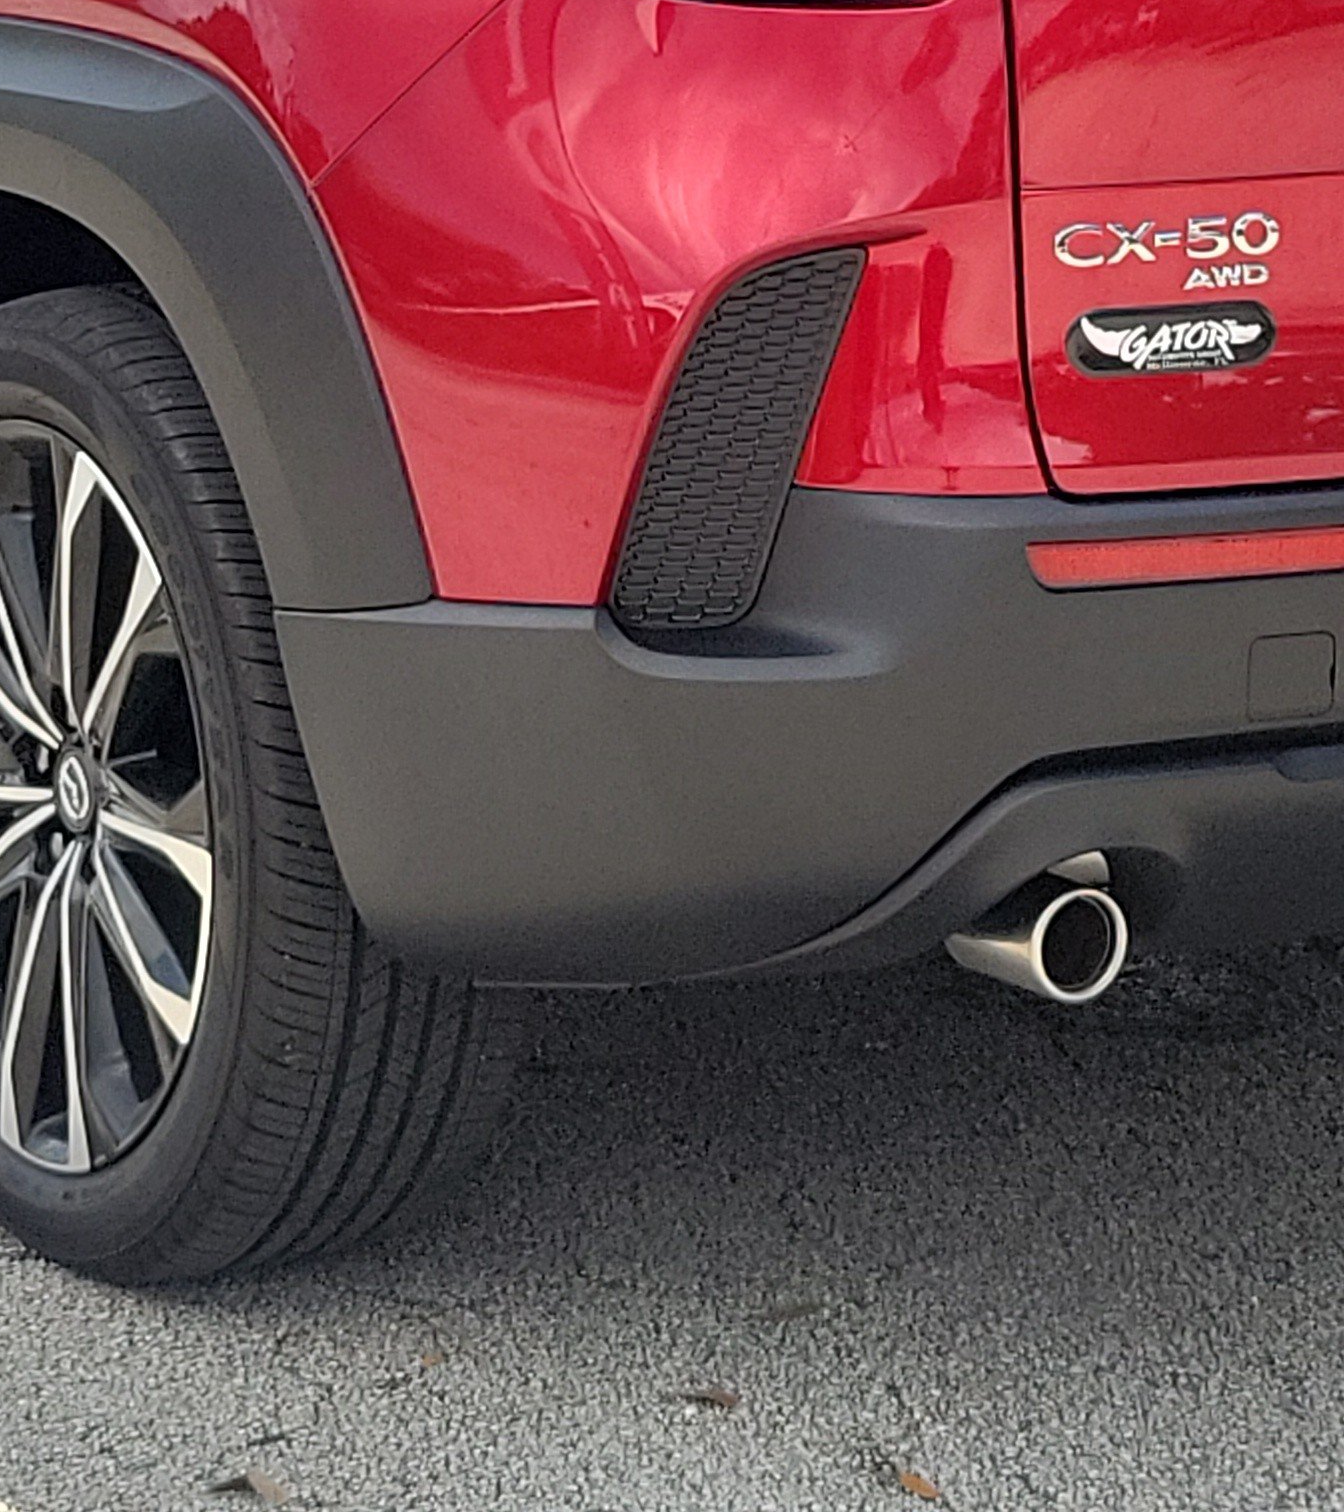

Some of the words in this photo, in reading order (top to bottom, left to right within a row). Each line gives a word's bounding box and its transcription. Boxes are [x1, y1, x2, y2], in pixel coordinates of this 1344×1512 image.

[1054, 211, 1280, 268] CX-50
[1183, 263, 1270, 291] AWD
[1119, 318, 1236, 370] GATOR
